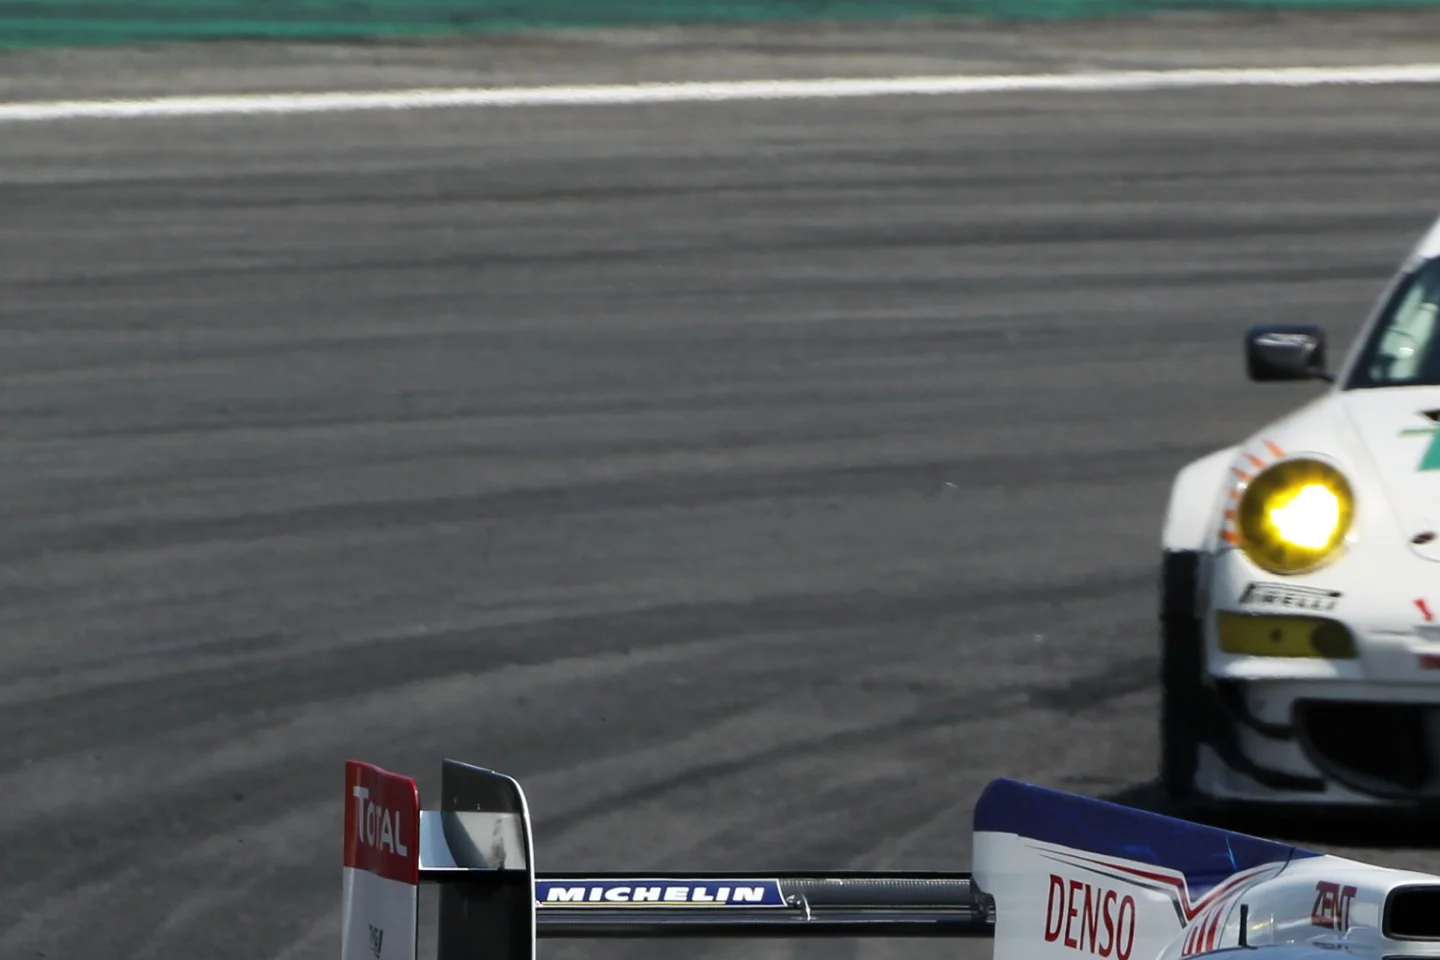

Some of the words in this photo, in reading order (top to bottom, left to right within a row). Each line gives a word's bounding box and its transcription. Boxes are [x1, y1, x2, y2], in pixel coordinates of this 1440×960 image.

[353, 785, 408, 858] TOTAL
[546, 886, 765, 902] MICHELIN
[1311, 880, 1358, 932] ZENT
